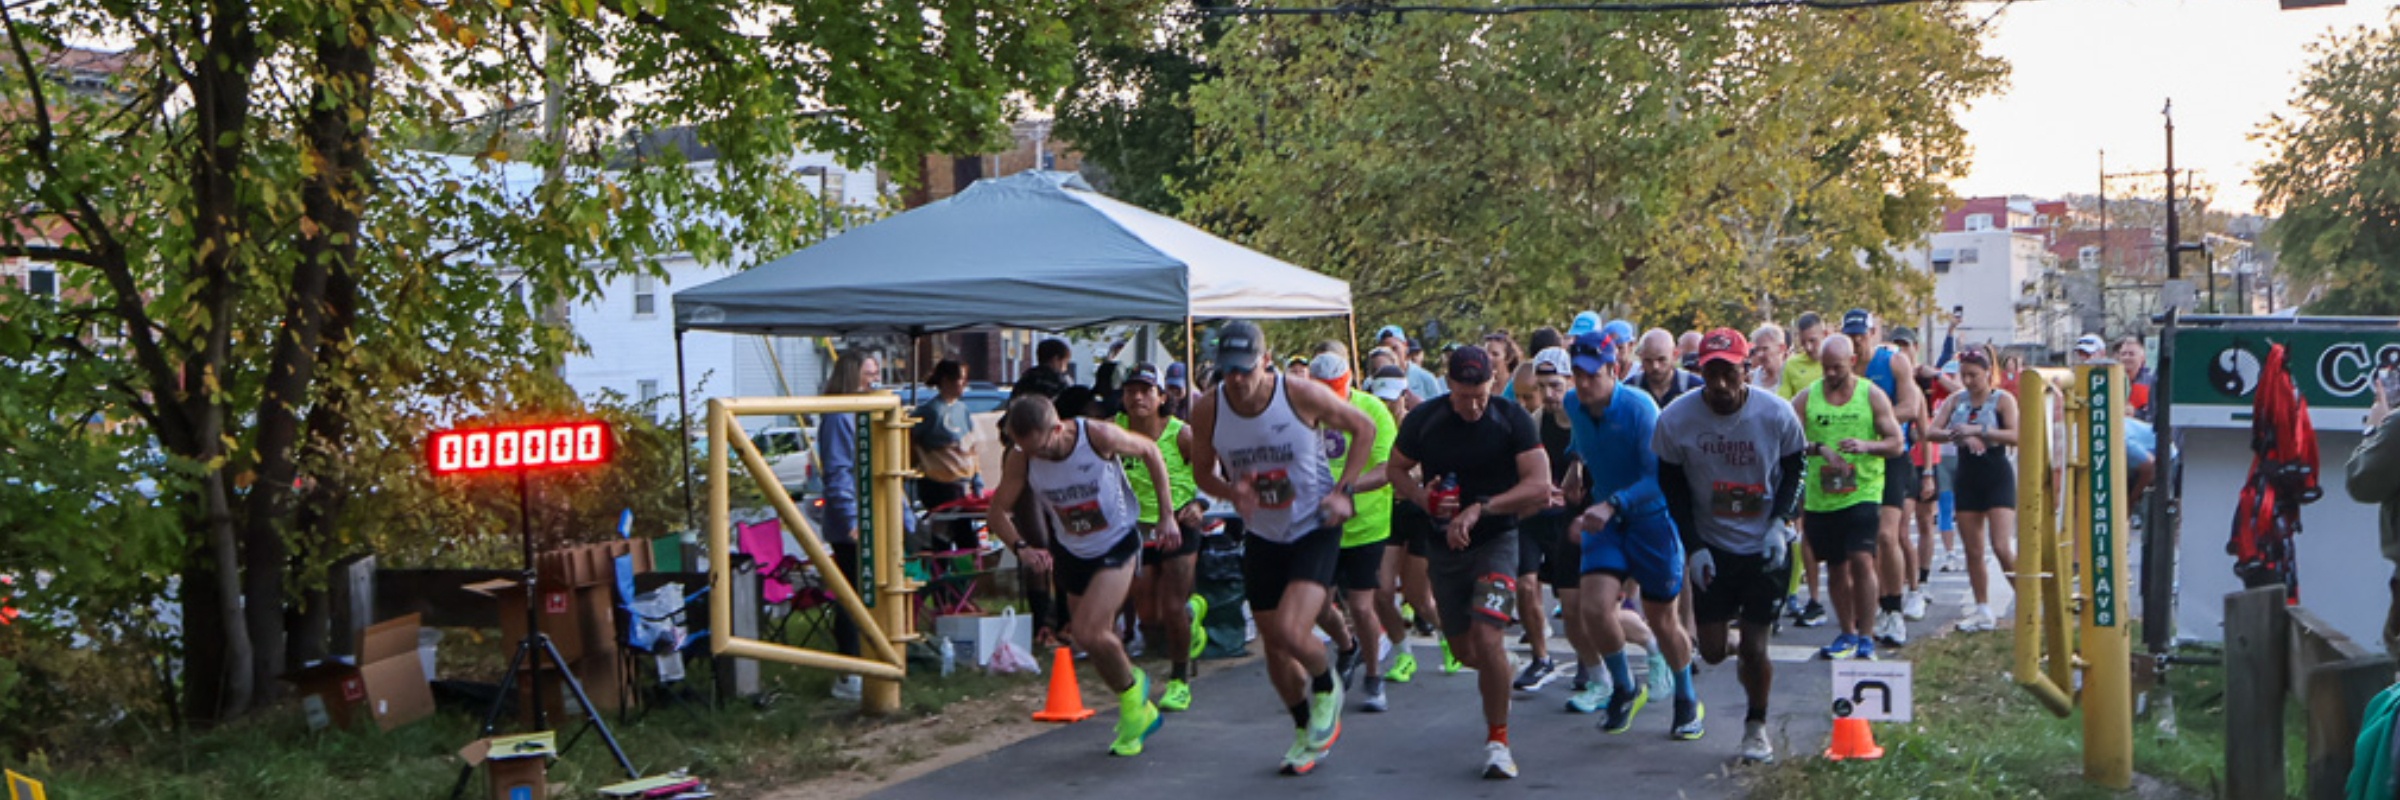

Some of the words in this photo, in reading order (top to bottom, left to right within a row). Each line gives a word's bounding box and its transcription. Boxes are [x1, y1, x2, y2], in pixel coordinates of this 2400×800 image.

[1702, 440, 1755, 454] FLORIDA
[1725, 453, 1757, 466] TECH
[858, 414, 871, 558] ennsylvania
[2091, 375, 2108, 569] Pennsylvania
[861, 564, 873, 604] Ave
[1484, 592, 1505, 612] 22
[2094, 578, 2111, 624] Ave
